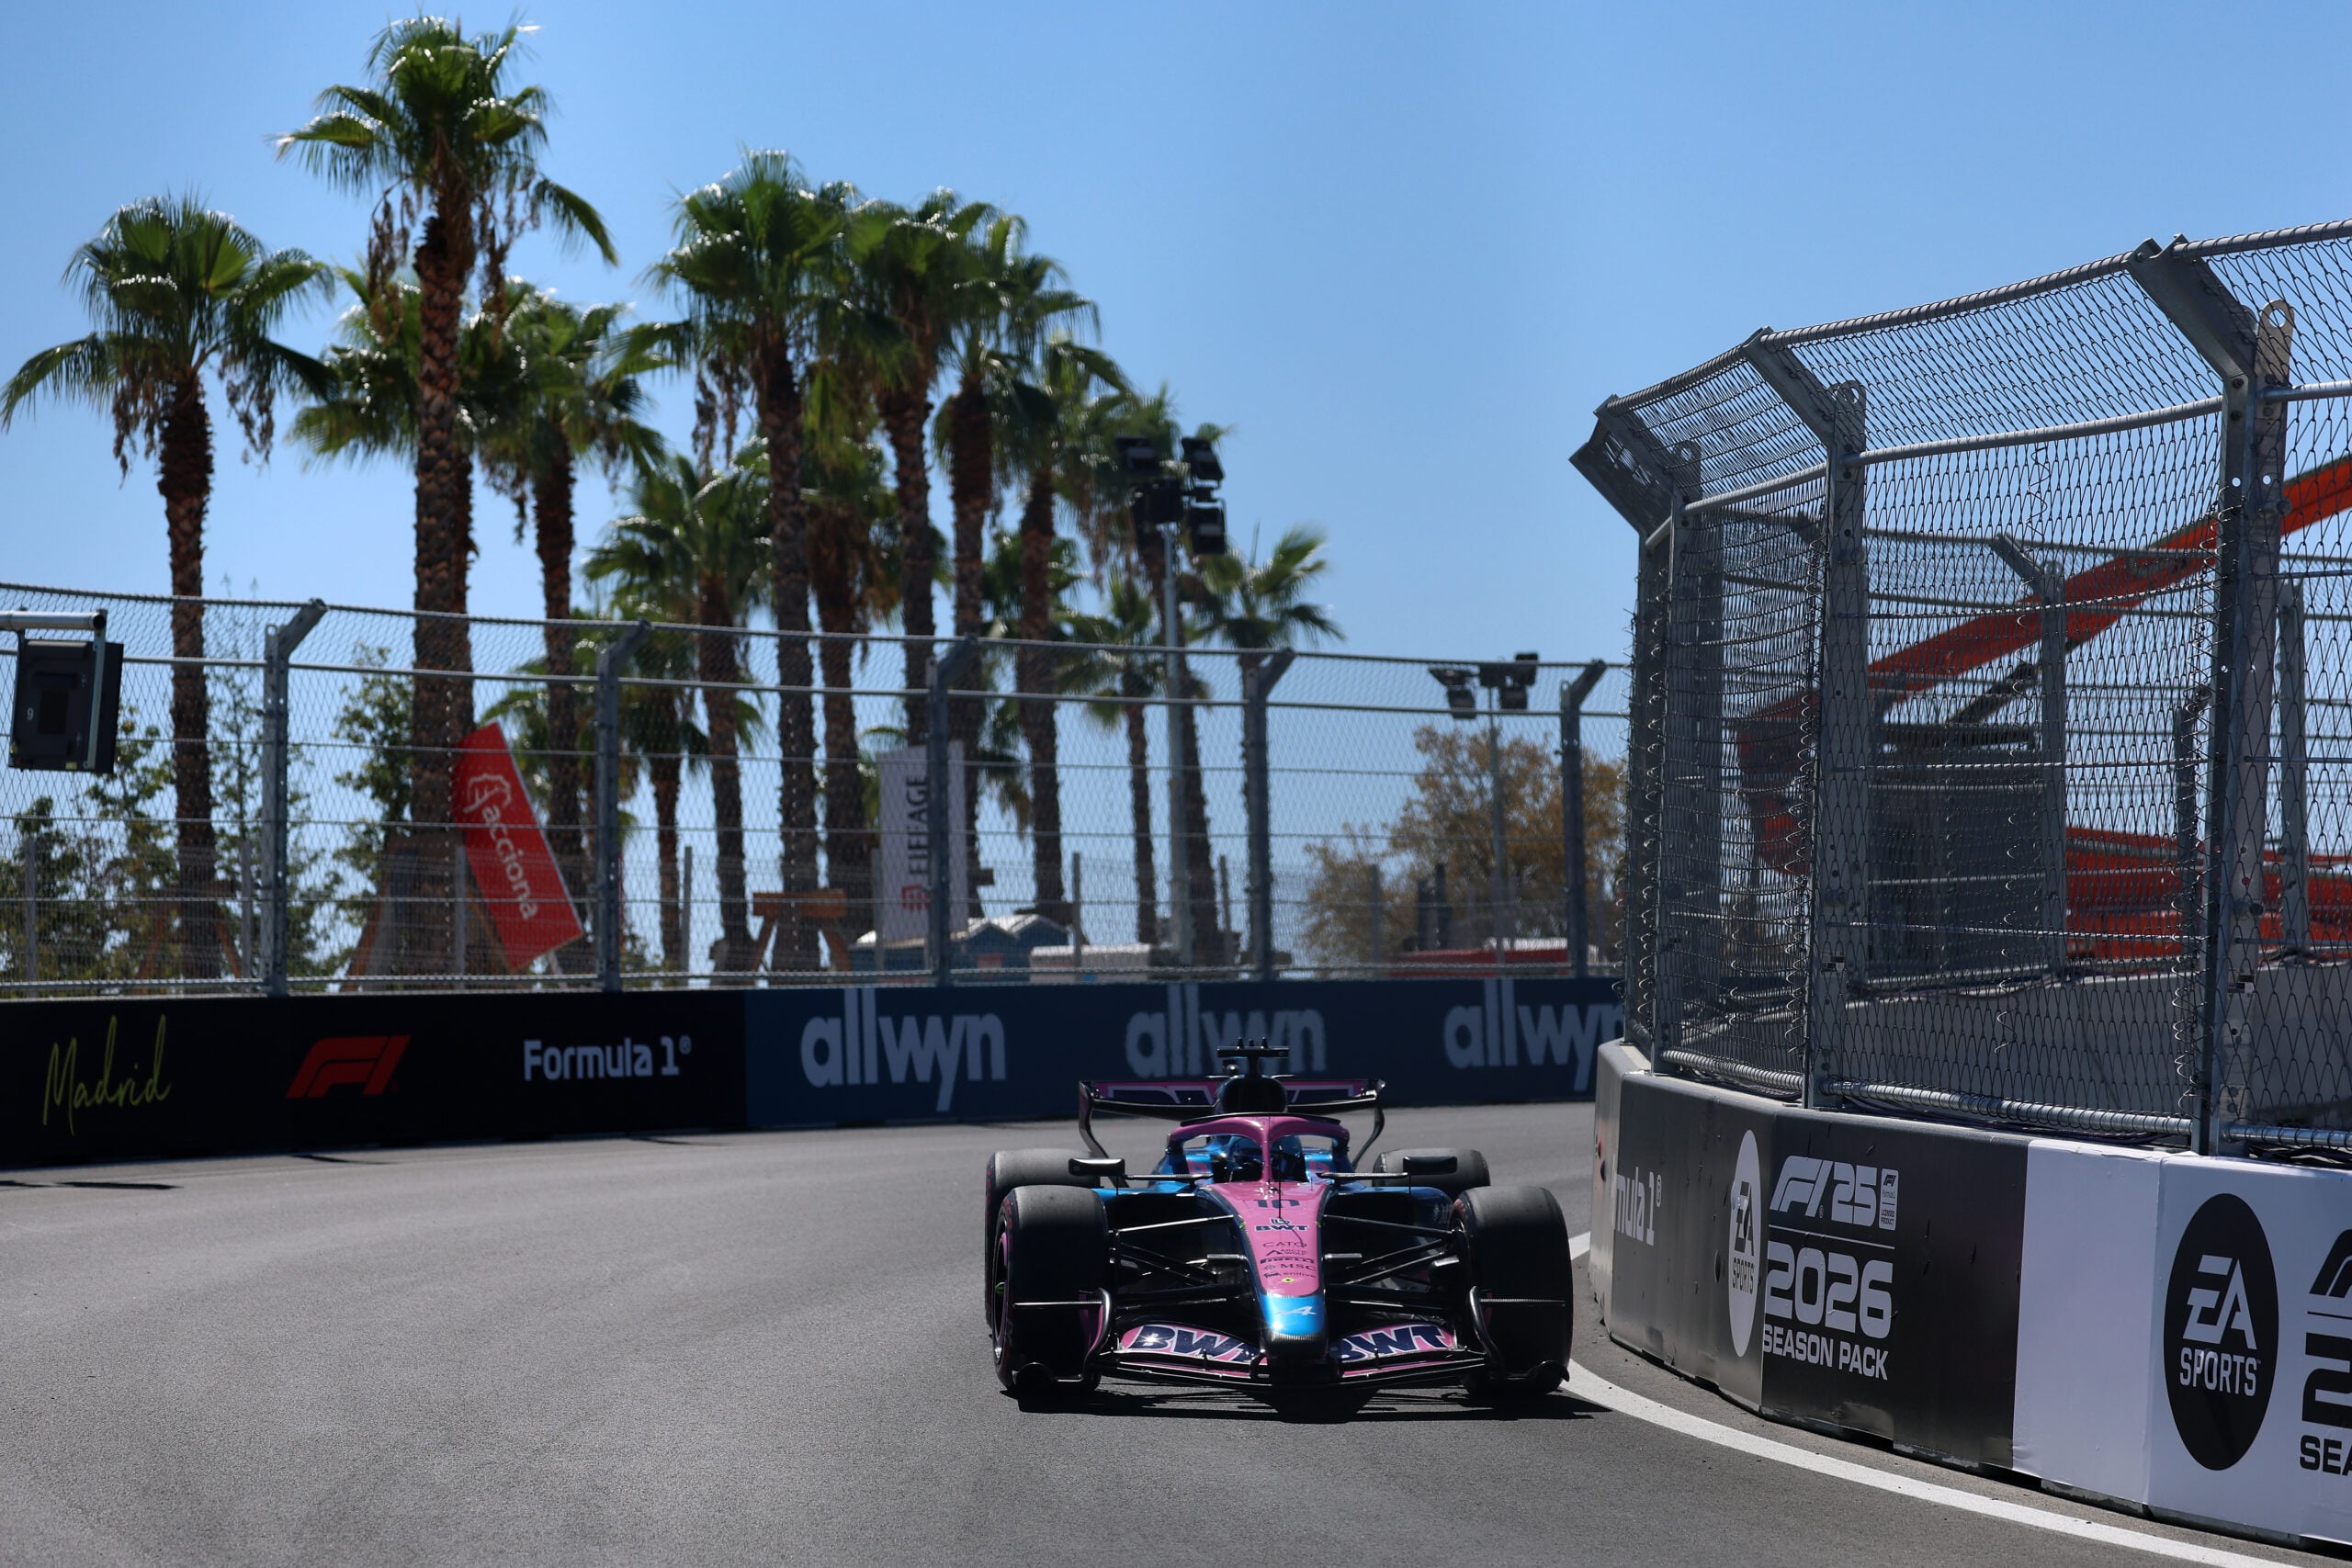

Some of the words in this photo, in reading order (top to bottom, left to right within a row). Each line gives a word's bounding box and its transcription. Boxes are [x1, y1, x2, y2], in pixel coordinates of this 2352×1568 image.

[481, 805, 539, 920] acciona
[42, 1013, 172, 1137] Madrid
[523, 1038, 653, 1081] Formula
[800, 988, 1007, 1113] allwyn
[1734, 1180, 1755, 1258] EA
[1731, 1257, 1755, 1295] SPORTS
[1764, 1240, 1894, 1339] 2026
[2182, 1254, 2256, 1350] EA
[1762, 1323, 1834, 1368] SEASON
[1838, 1341, 1889, 1380] PACK
[2178, 1347, 2257, 1397] SPORTS
